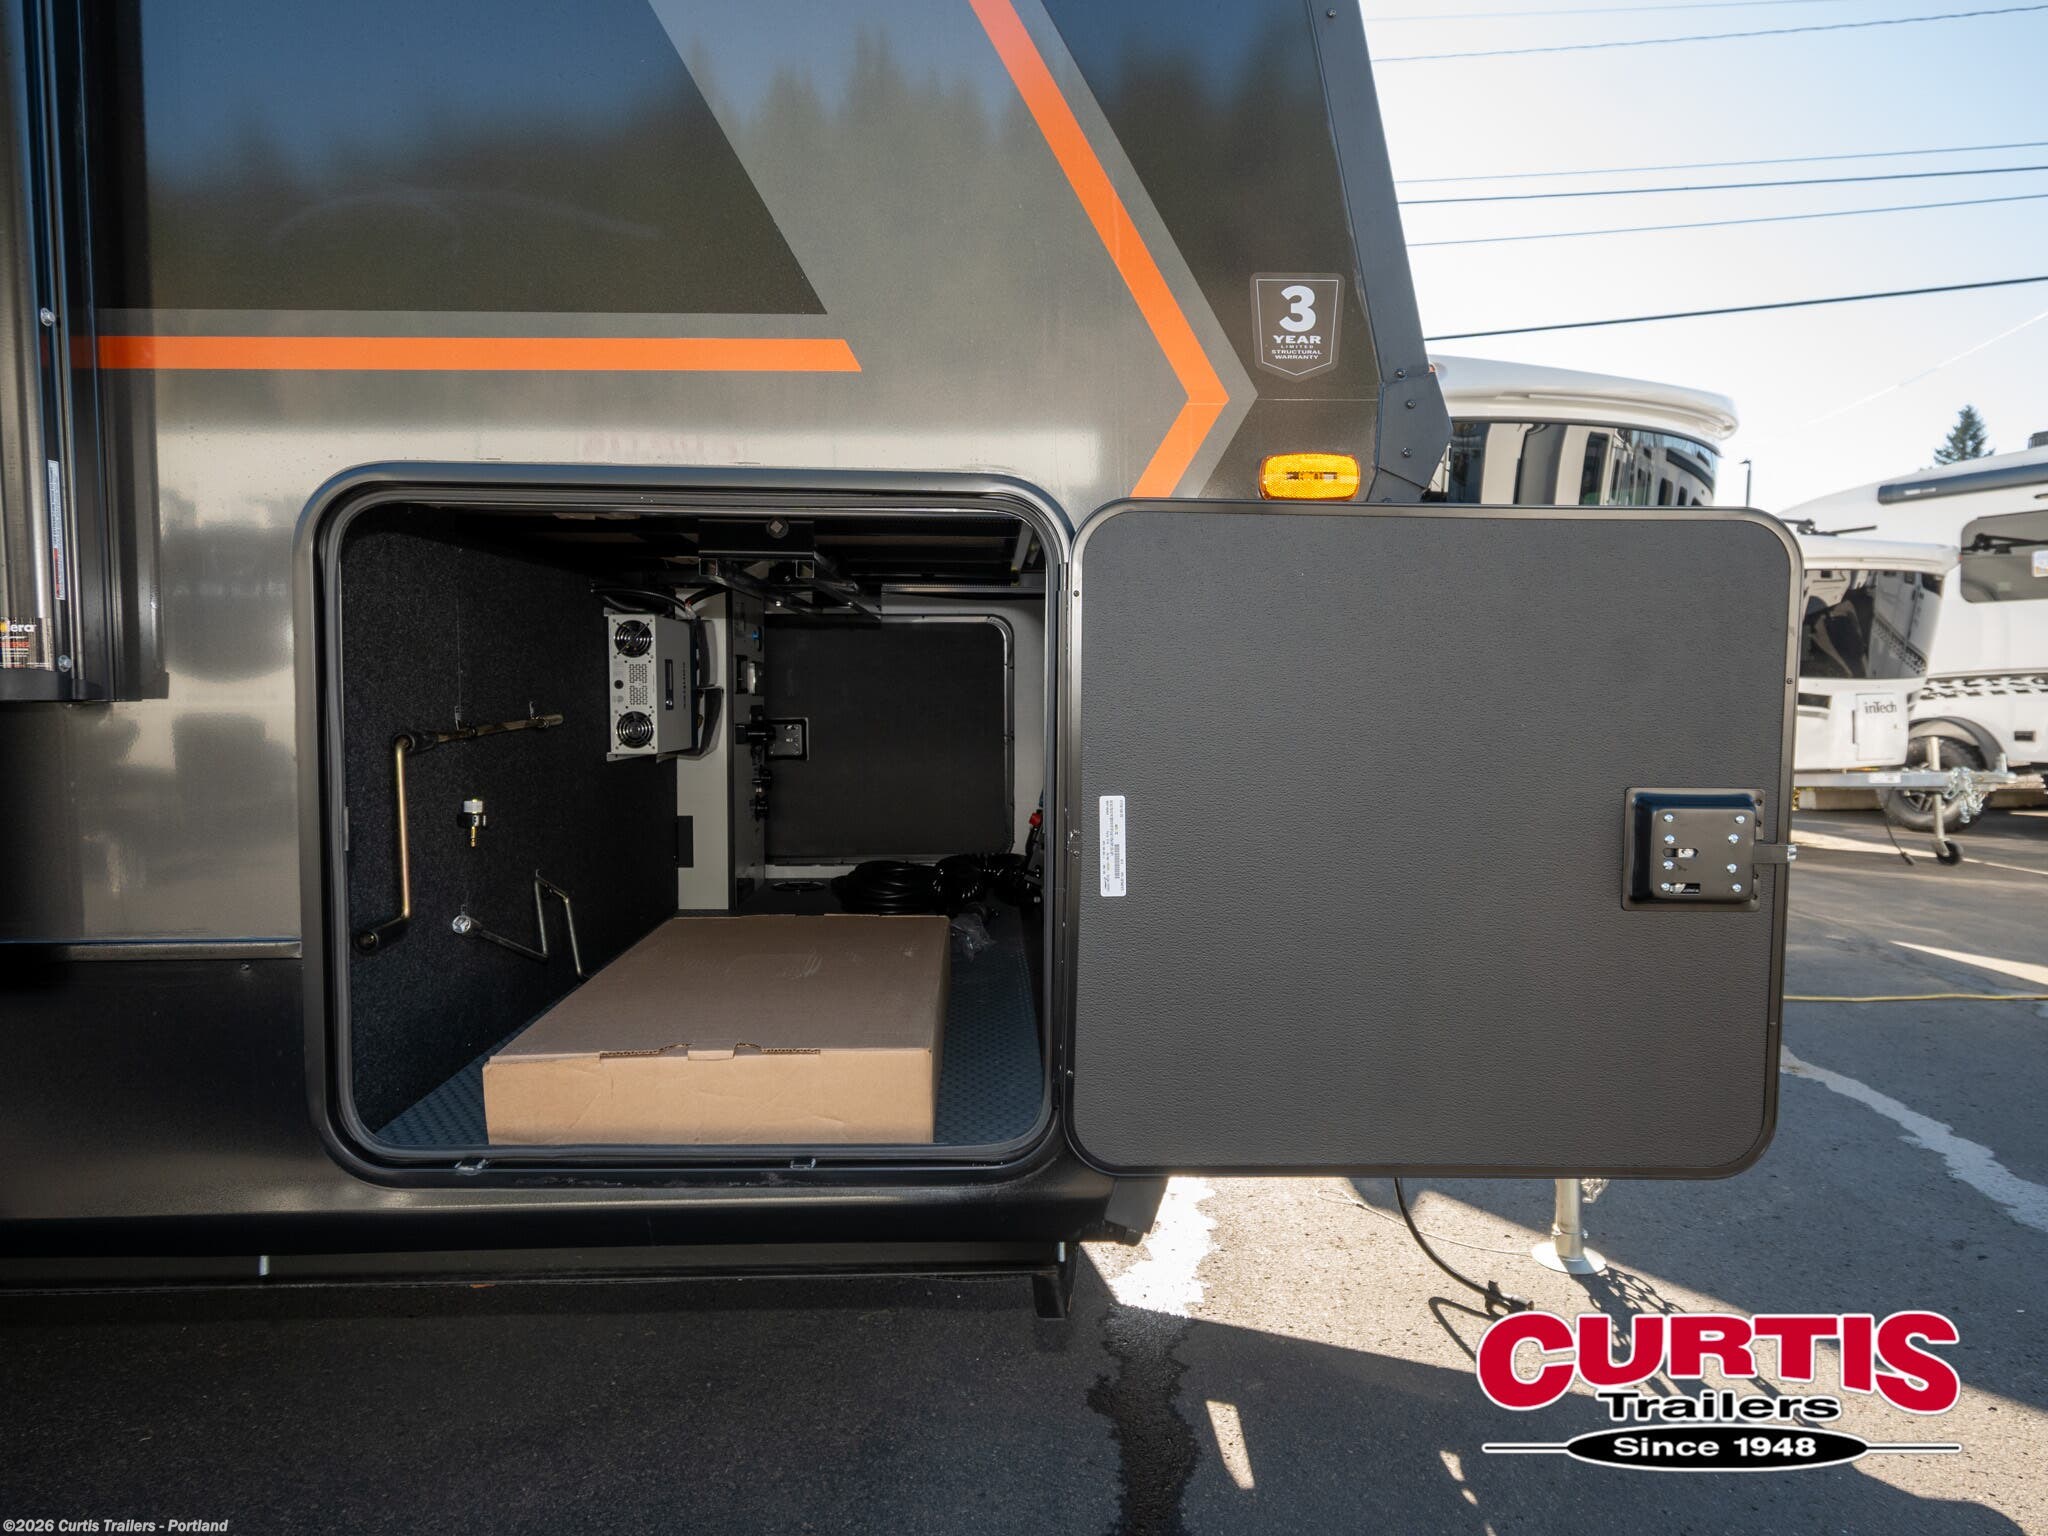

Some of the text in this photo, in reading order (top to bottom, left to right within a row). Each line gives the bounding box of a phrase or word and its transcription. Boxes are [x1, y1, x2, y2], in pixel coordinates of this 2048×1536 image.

[1279, 285, 1317, 333] 3
[1272, 335, 1322, 344] YEAR
[1864, 701, 1897, 714] inTech
